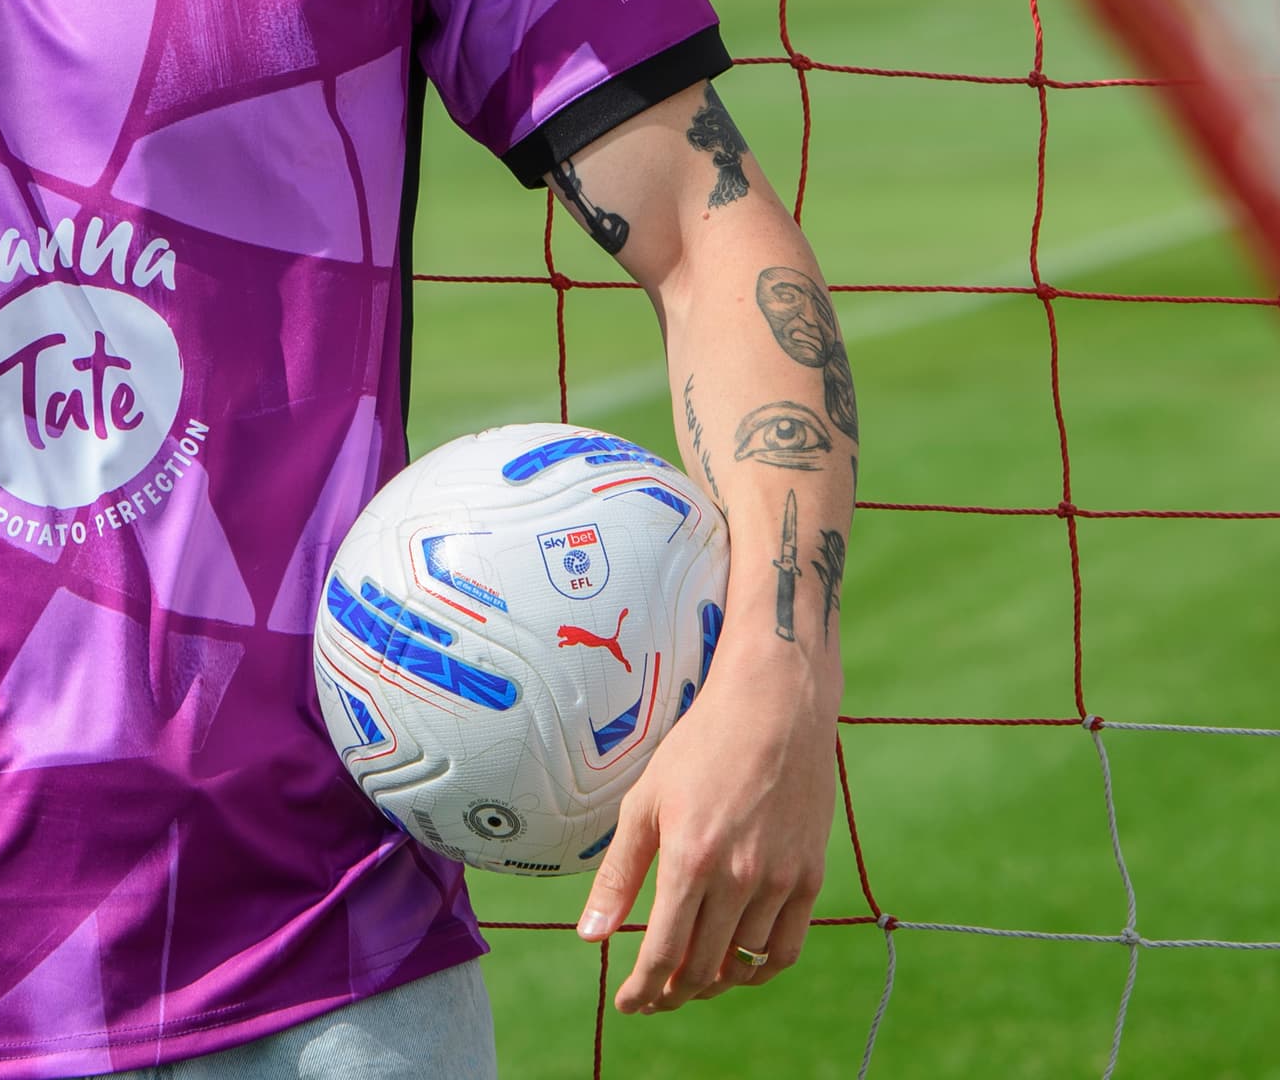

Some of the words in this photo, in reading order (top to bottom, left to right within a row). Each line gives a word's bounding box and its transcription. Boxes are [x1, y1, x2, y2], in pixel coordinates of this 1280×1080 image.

[95, 419, 210, 537] PERFECTION
[544, 537, 565, 549] sky
[570, 531, 593, 544] bet
[570, 576, 593, 590] EFL
